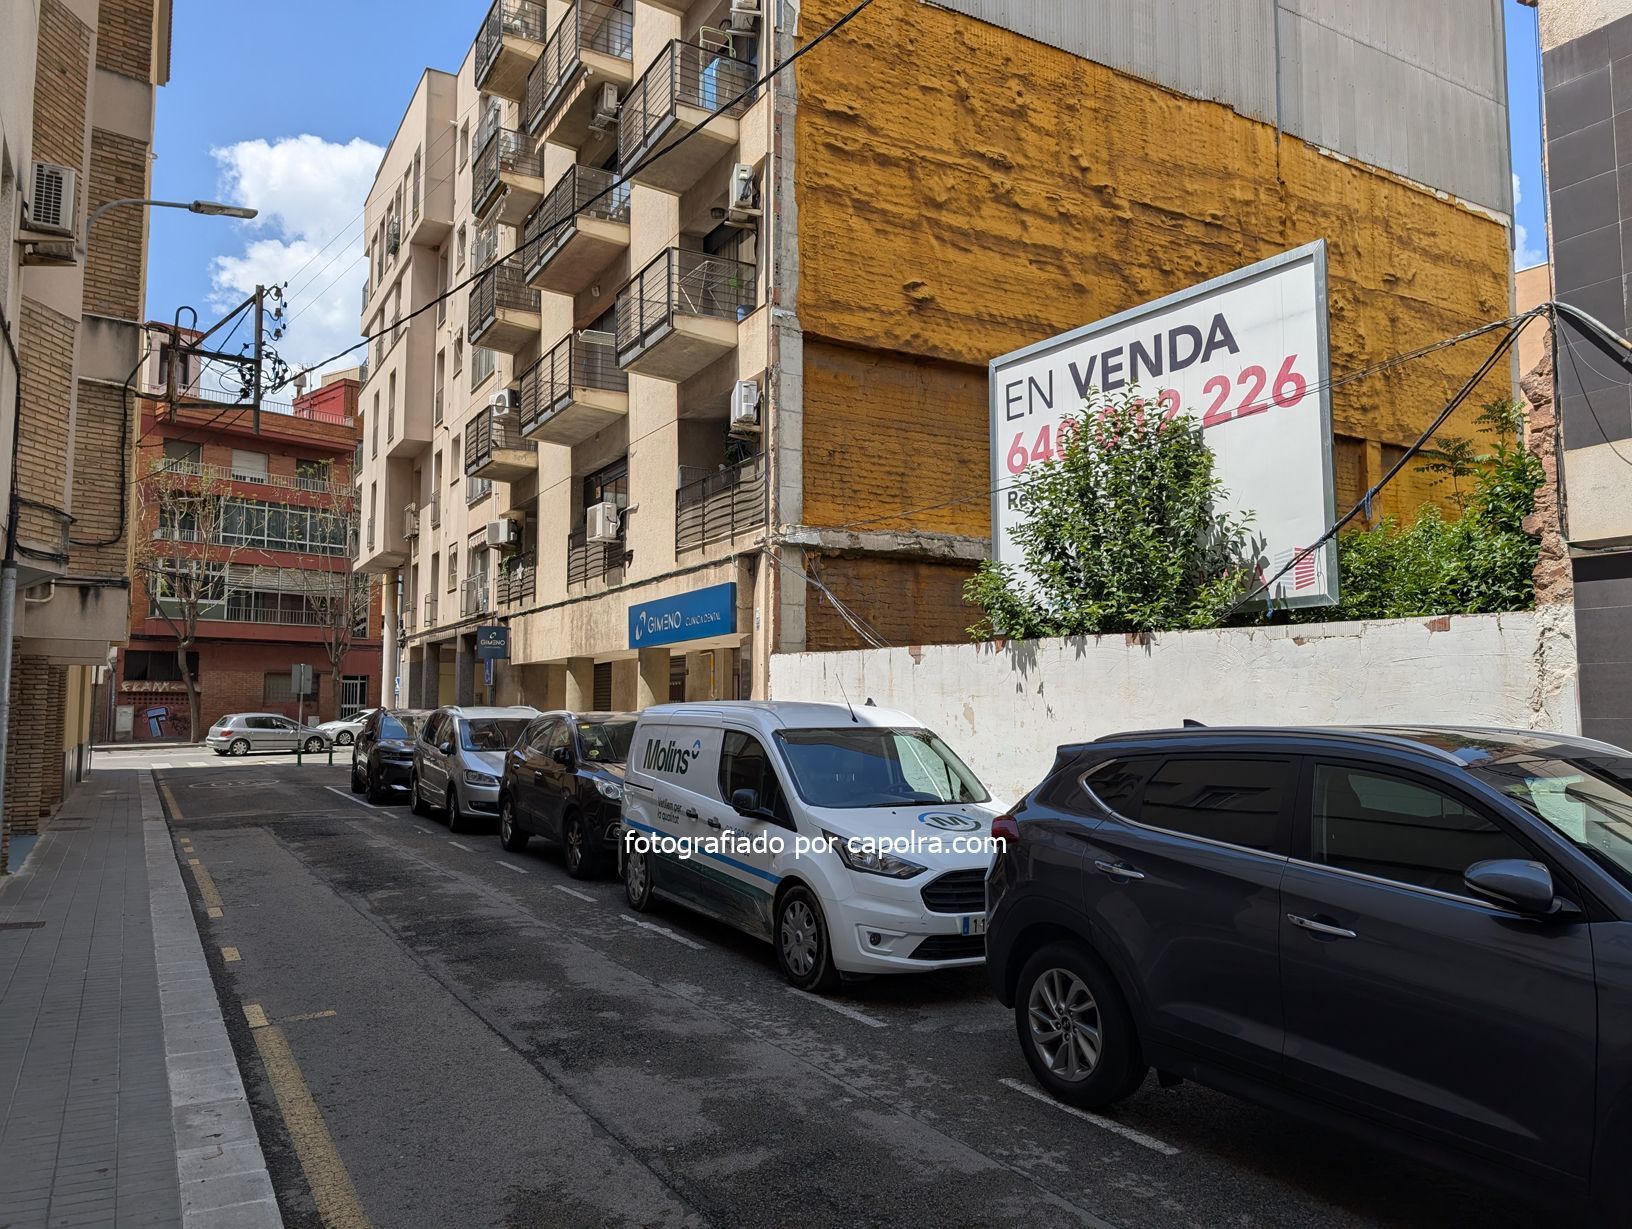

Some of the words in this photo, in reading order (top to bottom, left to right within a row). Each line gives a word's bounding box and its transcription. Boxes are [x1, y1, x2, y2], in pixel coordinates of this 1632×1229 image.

[1005, 370, 1054, 422] EN
[1067, 312, 1240, 400] VENDA
[1006, 417, 1083, 475] 640
[1202, 353, 1307, 430] 226
[647, 610, 682, 634] GIMENO
[643, 738, 690, 775] Molins
